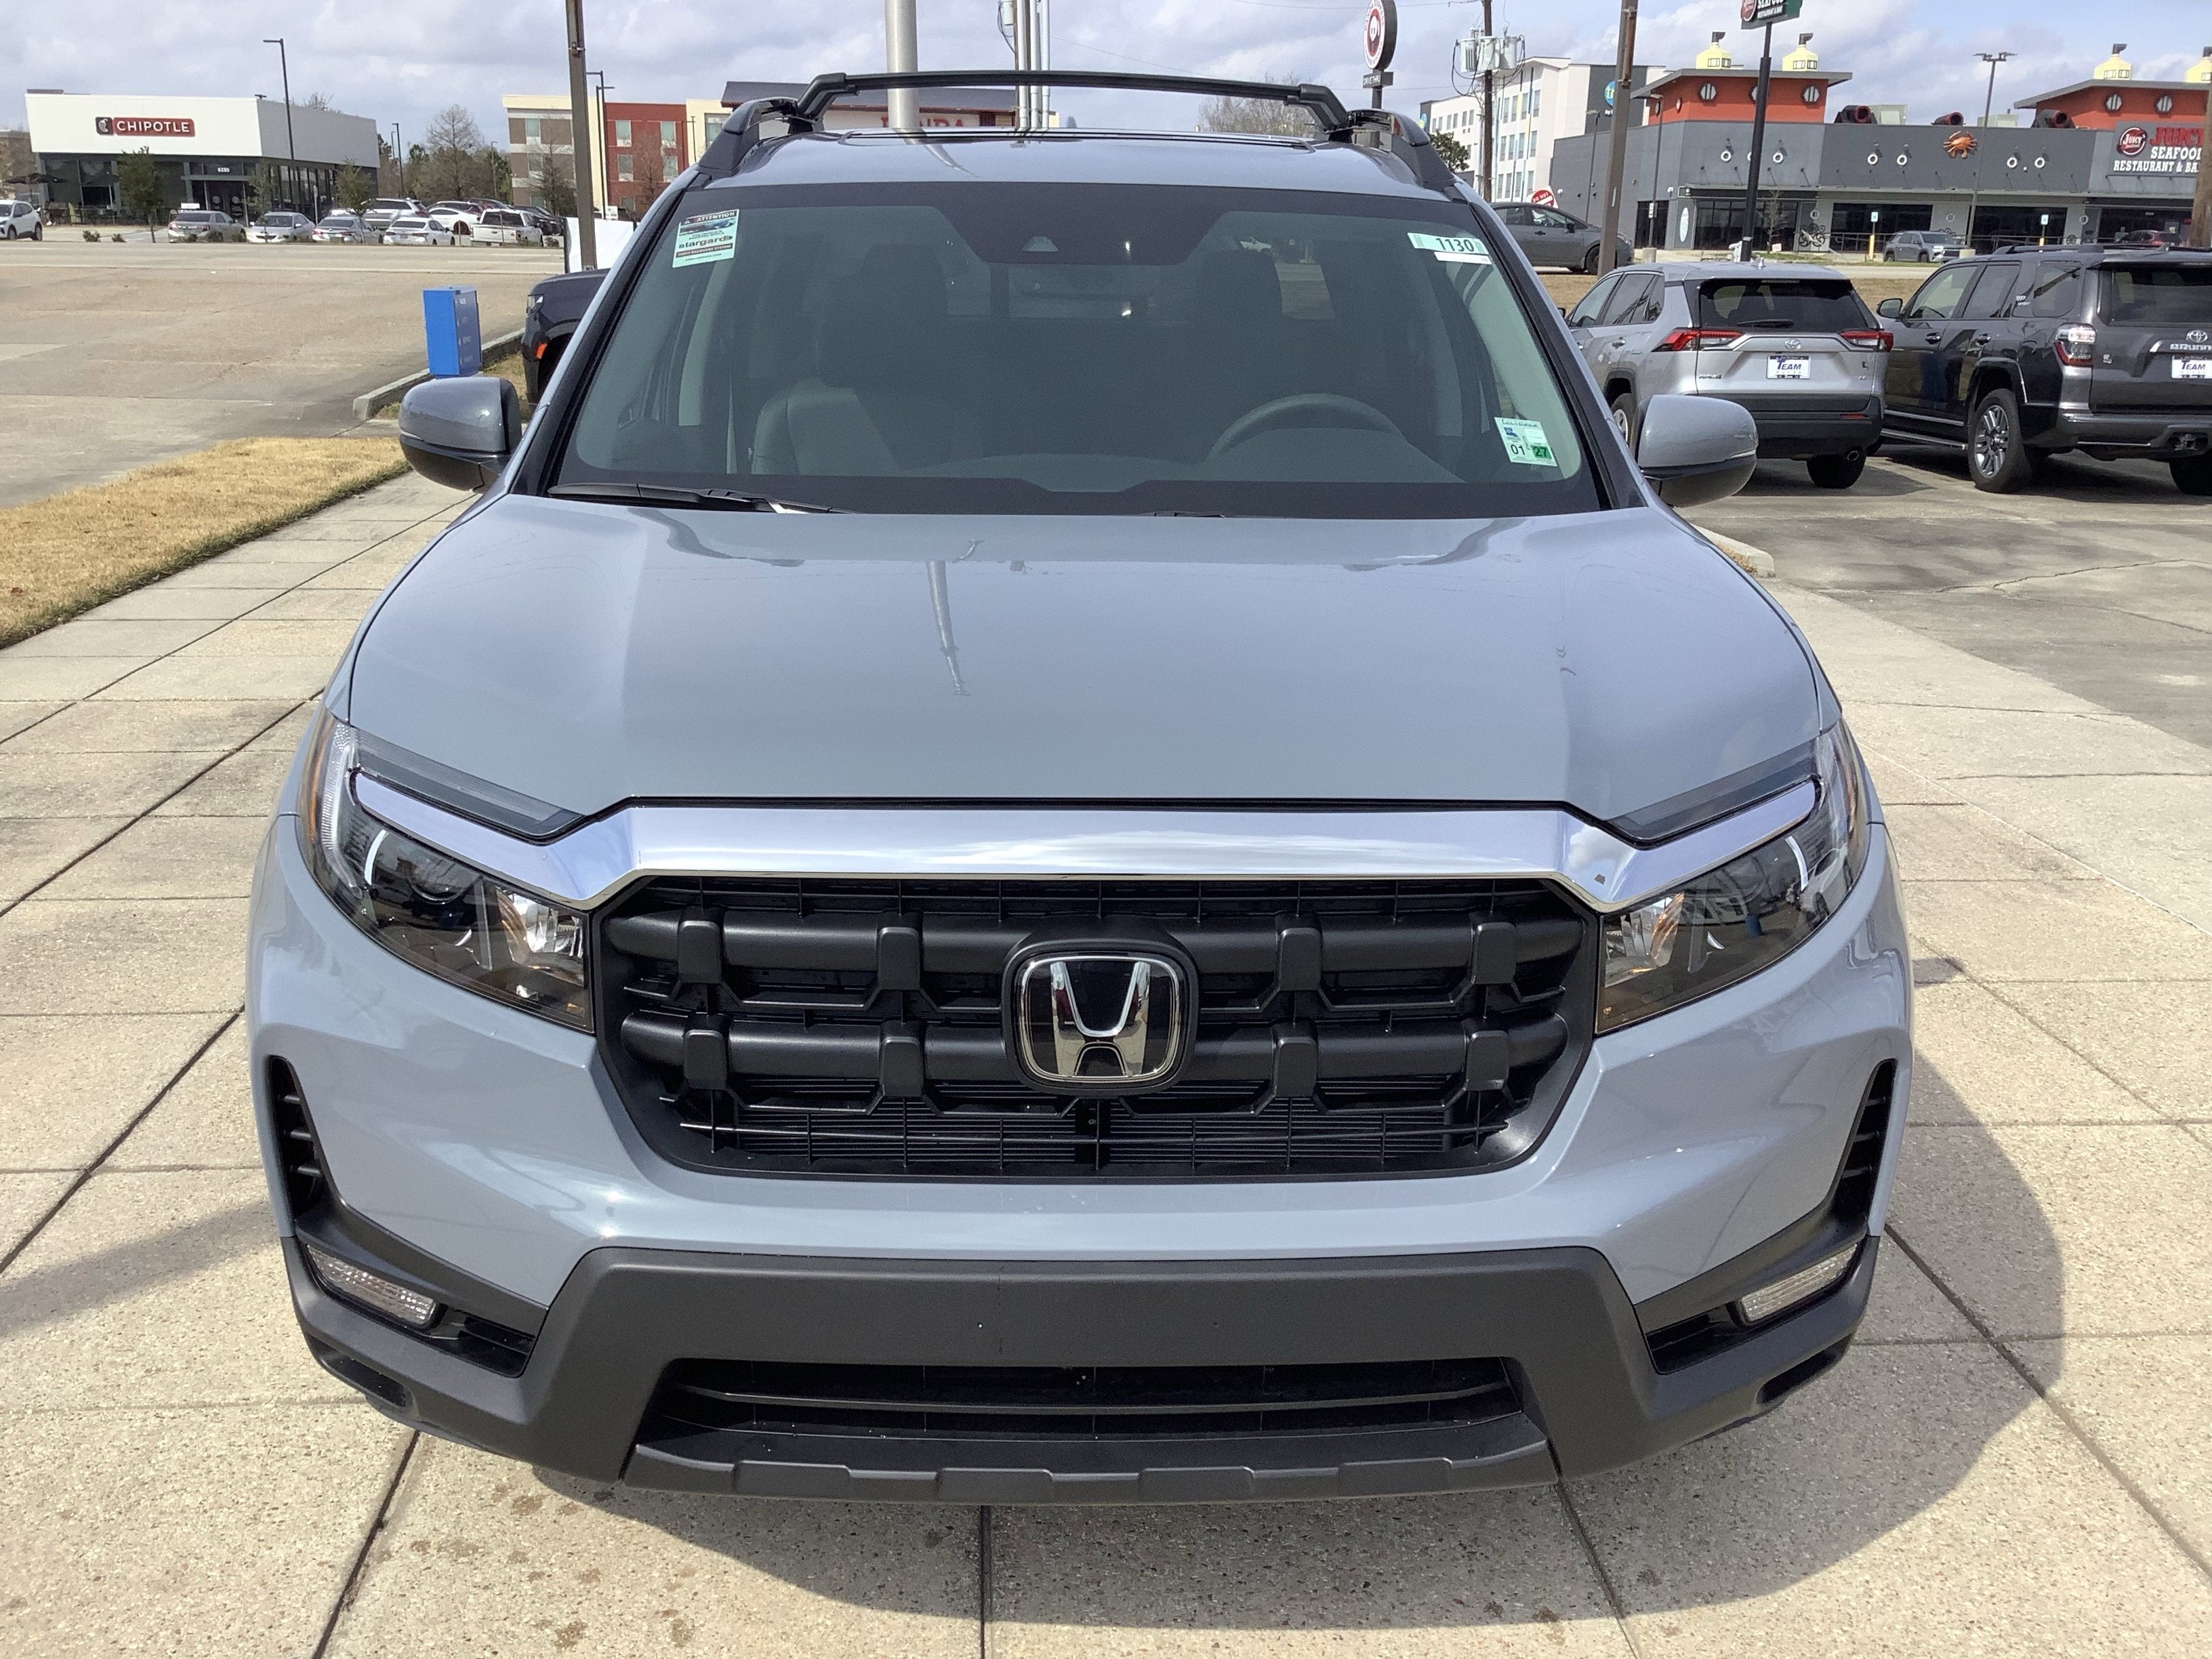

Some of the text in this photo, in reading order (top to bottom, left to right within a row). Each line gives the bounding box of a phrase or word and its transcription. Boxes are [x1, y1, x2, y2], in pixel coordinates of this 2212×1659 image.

[117, 121, 190, 133] CHIPOTLE
[2113, 160, 2200, 173] RESTAURANT & BA
[697, 211, 735, 222] ATTENTION
[678, 235, 728, 249] stargard
[1435, 238, 1475, 252] 1130
[1777, 357, 1802, 370] TEAM
[2181, 358, 2206, 370] TEAM
[1511, 444, 1525, 455] 01
[1532, 447, 1547, 457] 27
